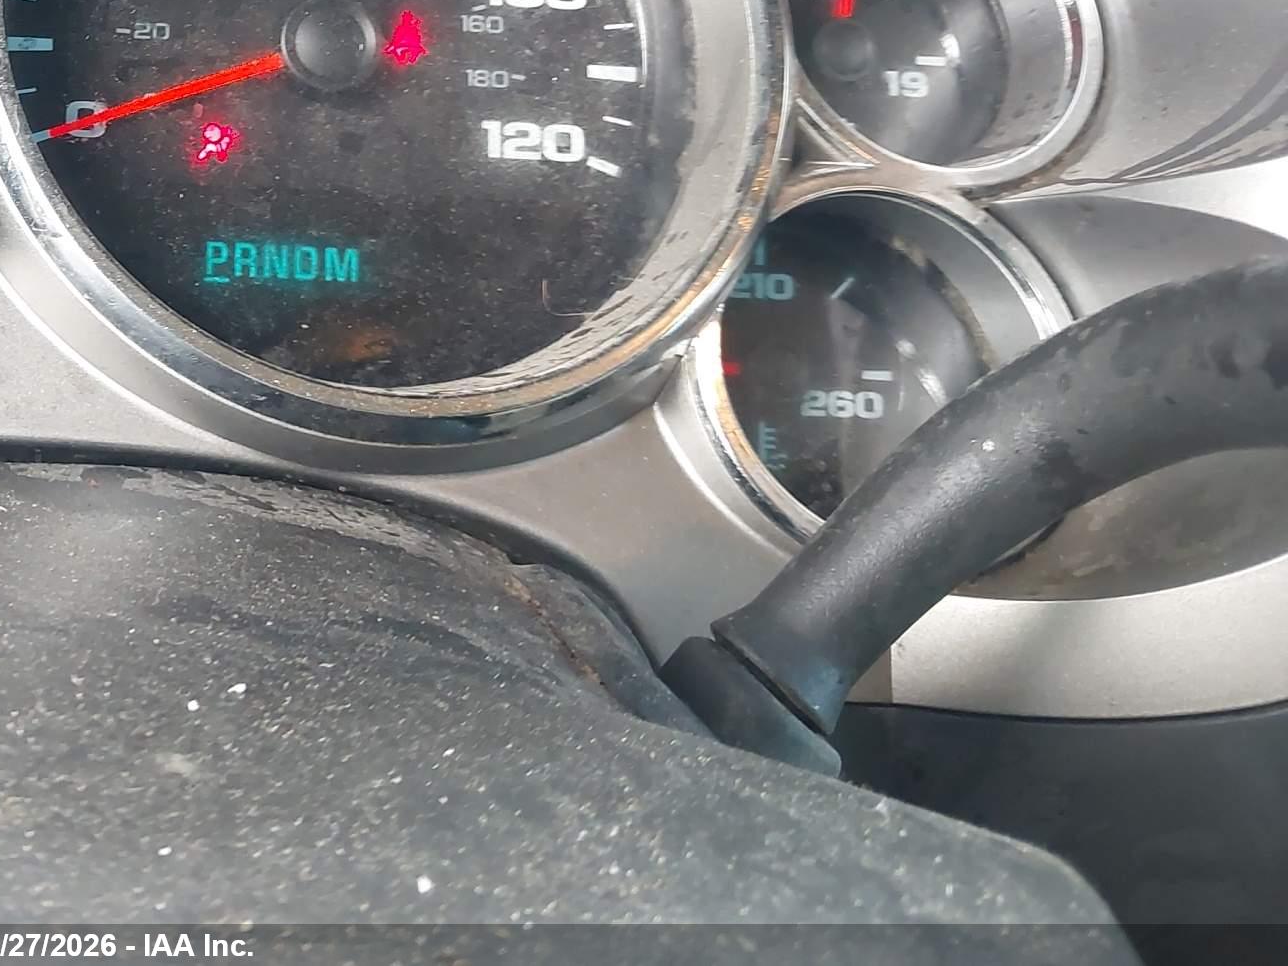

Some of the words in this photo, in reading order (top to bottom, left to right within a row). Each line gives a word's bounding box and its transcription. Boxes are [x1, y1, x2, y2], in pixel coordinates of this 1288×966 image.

[133, 22, 171, 42] 20
[461, 14, 504, 35] 160
[467, 70, 509, 89] 180
[884, 70, 929, 98] 19
[66, 101, 107, 138] 0
[481, 119, 586, 161] 120
[203, 240, 361, 283] PRNDM
[729, 272, 794, 300] 210
[801, 391, 884, 420] 260
